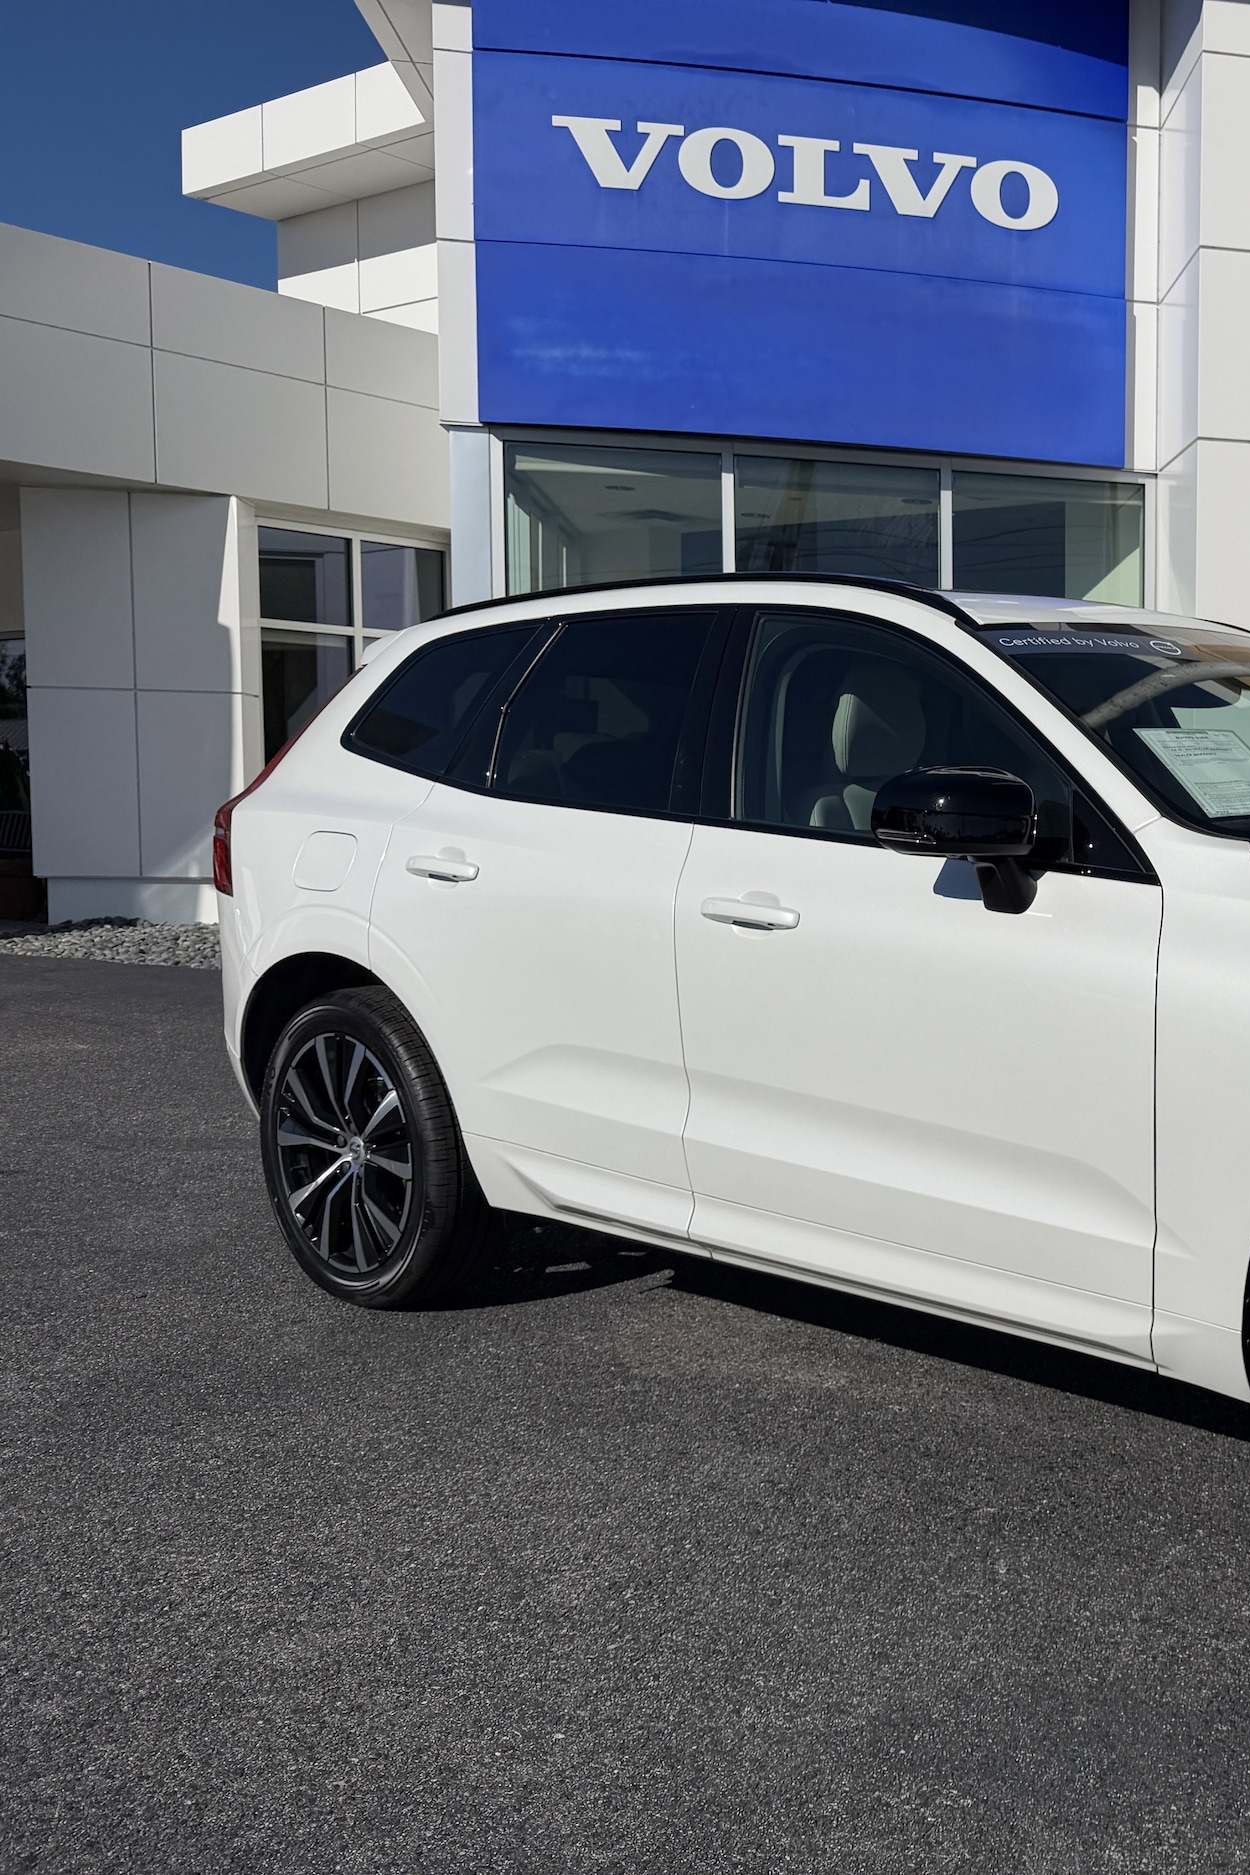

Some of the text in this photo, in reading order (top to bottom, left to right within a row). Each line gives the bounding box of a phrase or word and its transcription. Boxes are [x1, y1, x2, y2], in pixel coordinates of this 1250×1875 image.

[551, 115, 1059, 231] VOLVO
[999, 637, 1140, 649] Certified by Volvo
